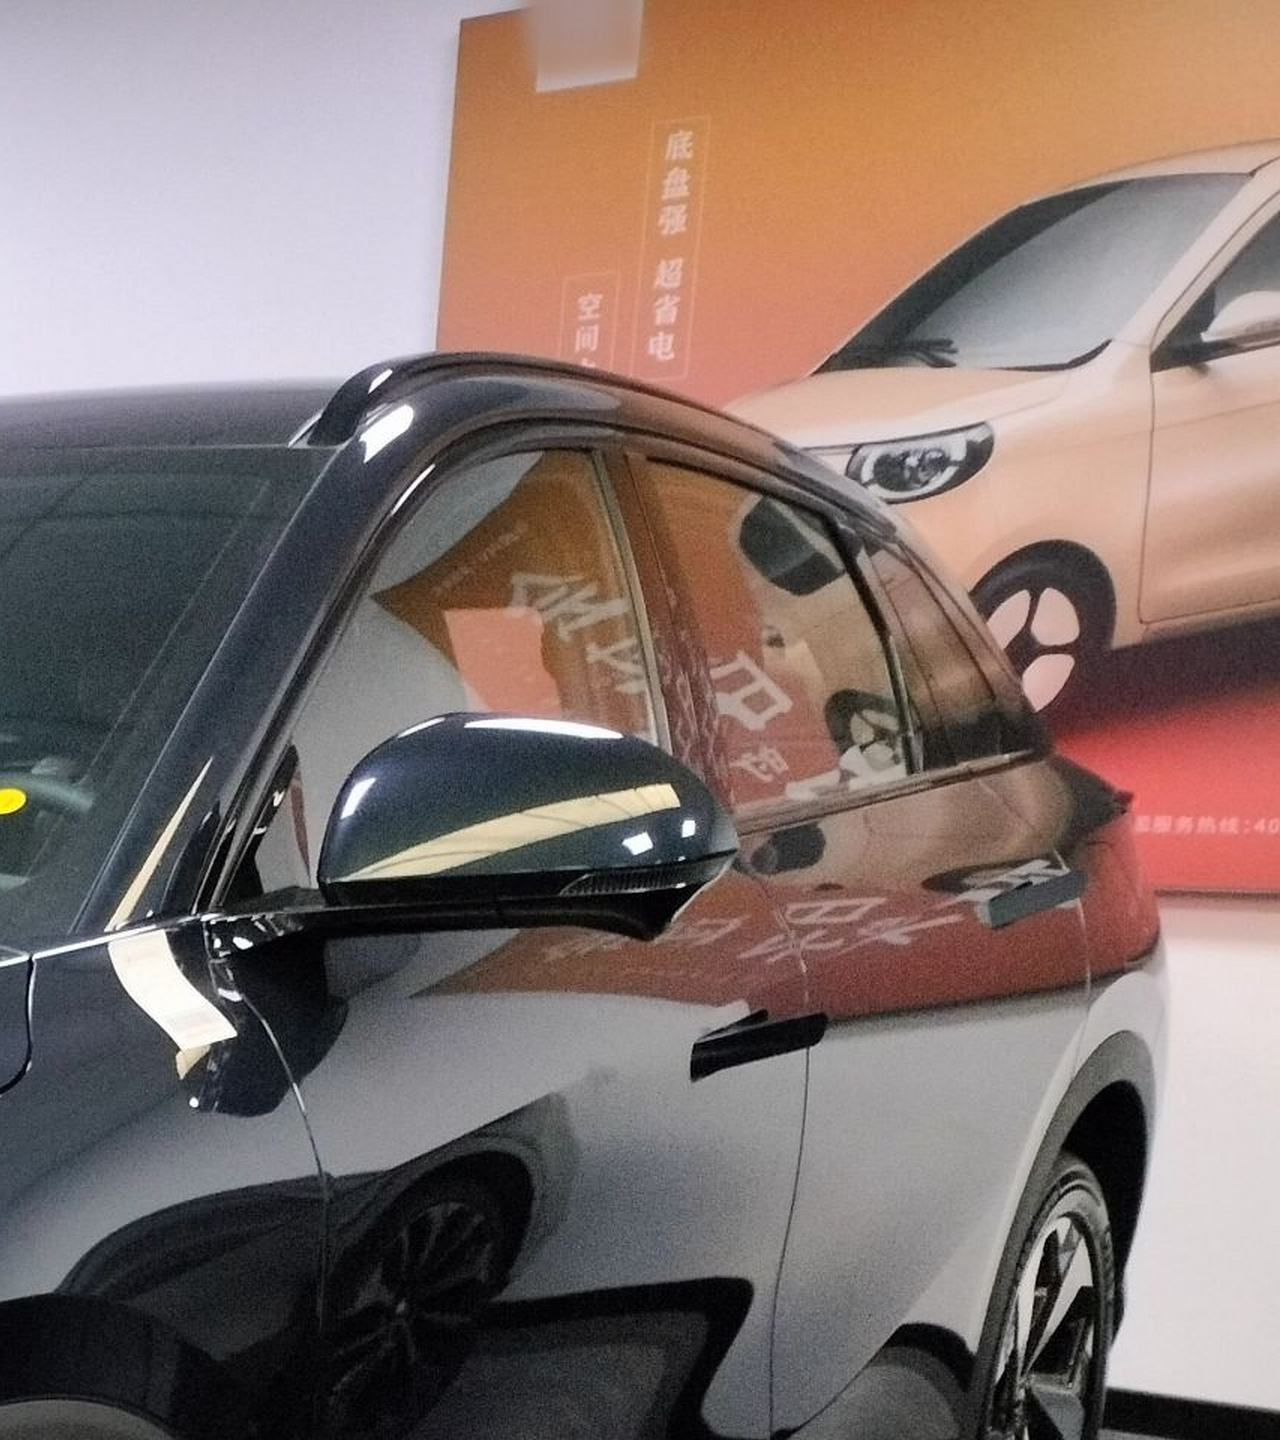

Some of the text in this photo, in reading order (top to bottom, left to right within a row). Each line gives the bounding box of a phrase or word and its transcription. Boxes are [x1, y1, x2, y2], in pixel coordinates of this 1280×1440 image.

[648, 130, 694, 361] 底盘强 超省电
